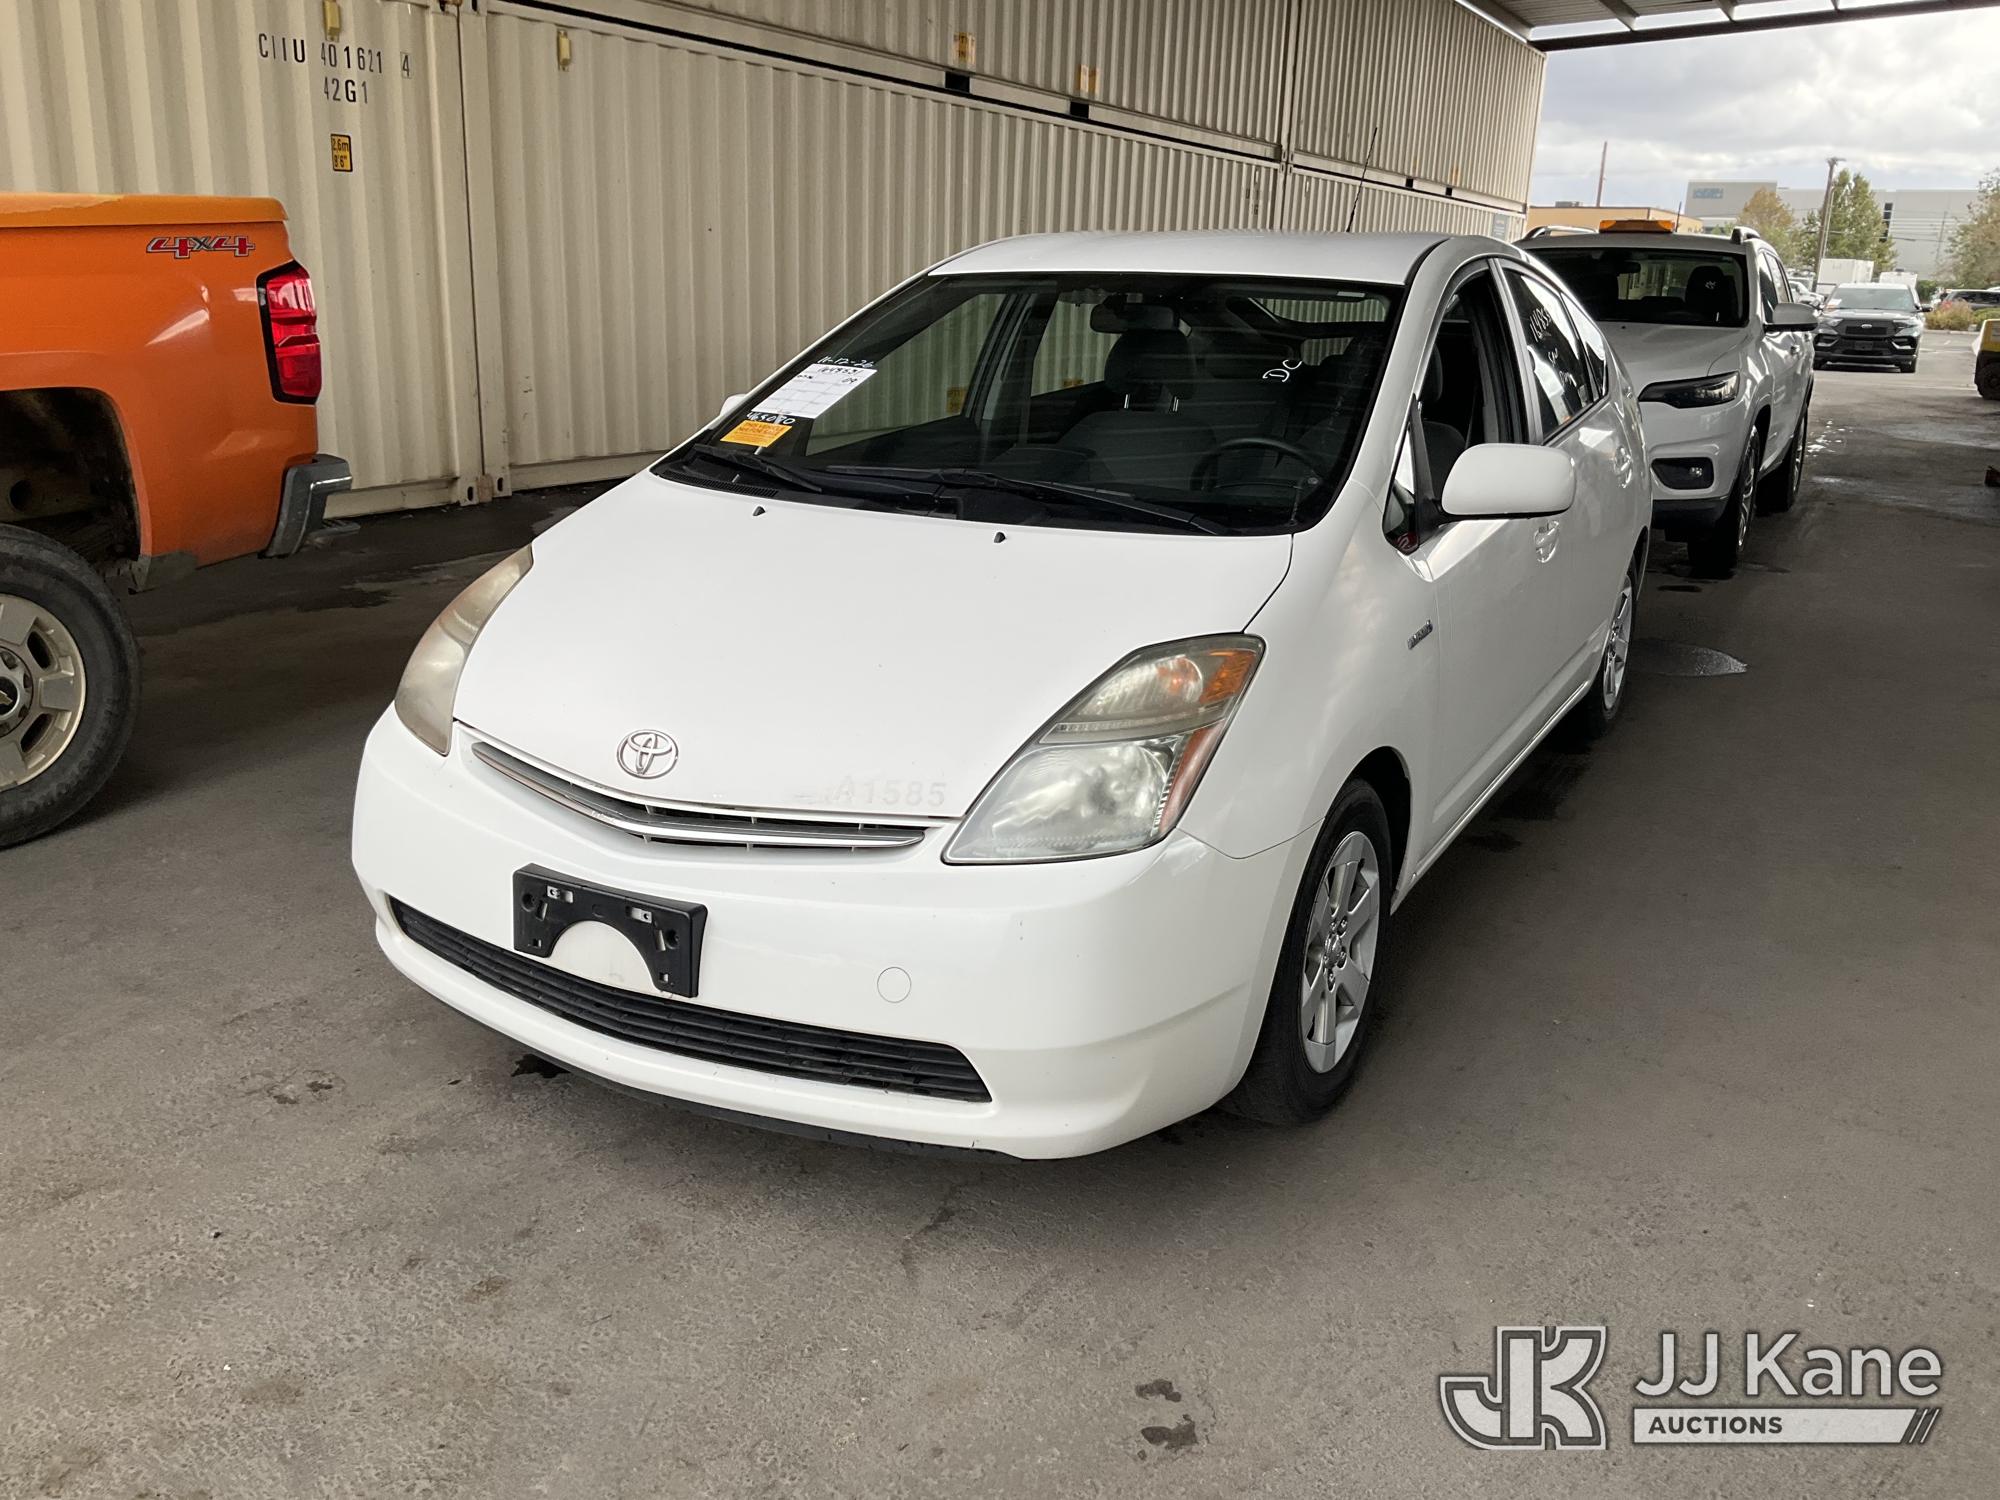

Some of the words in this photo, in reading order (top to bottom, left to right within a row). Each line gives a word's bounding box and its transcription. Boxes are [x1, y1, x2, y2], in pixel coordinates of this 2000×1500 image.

[321, 42, 382, 74] 401621
[402, 54, 411, 77] 4
[324, 76, 368, 104] 42G1
